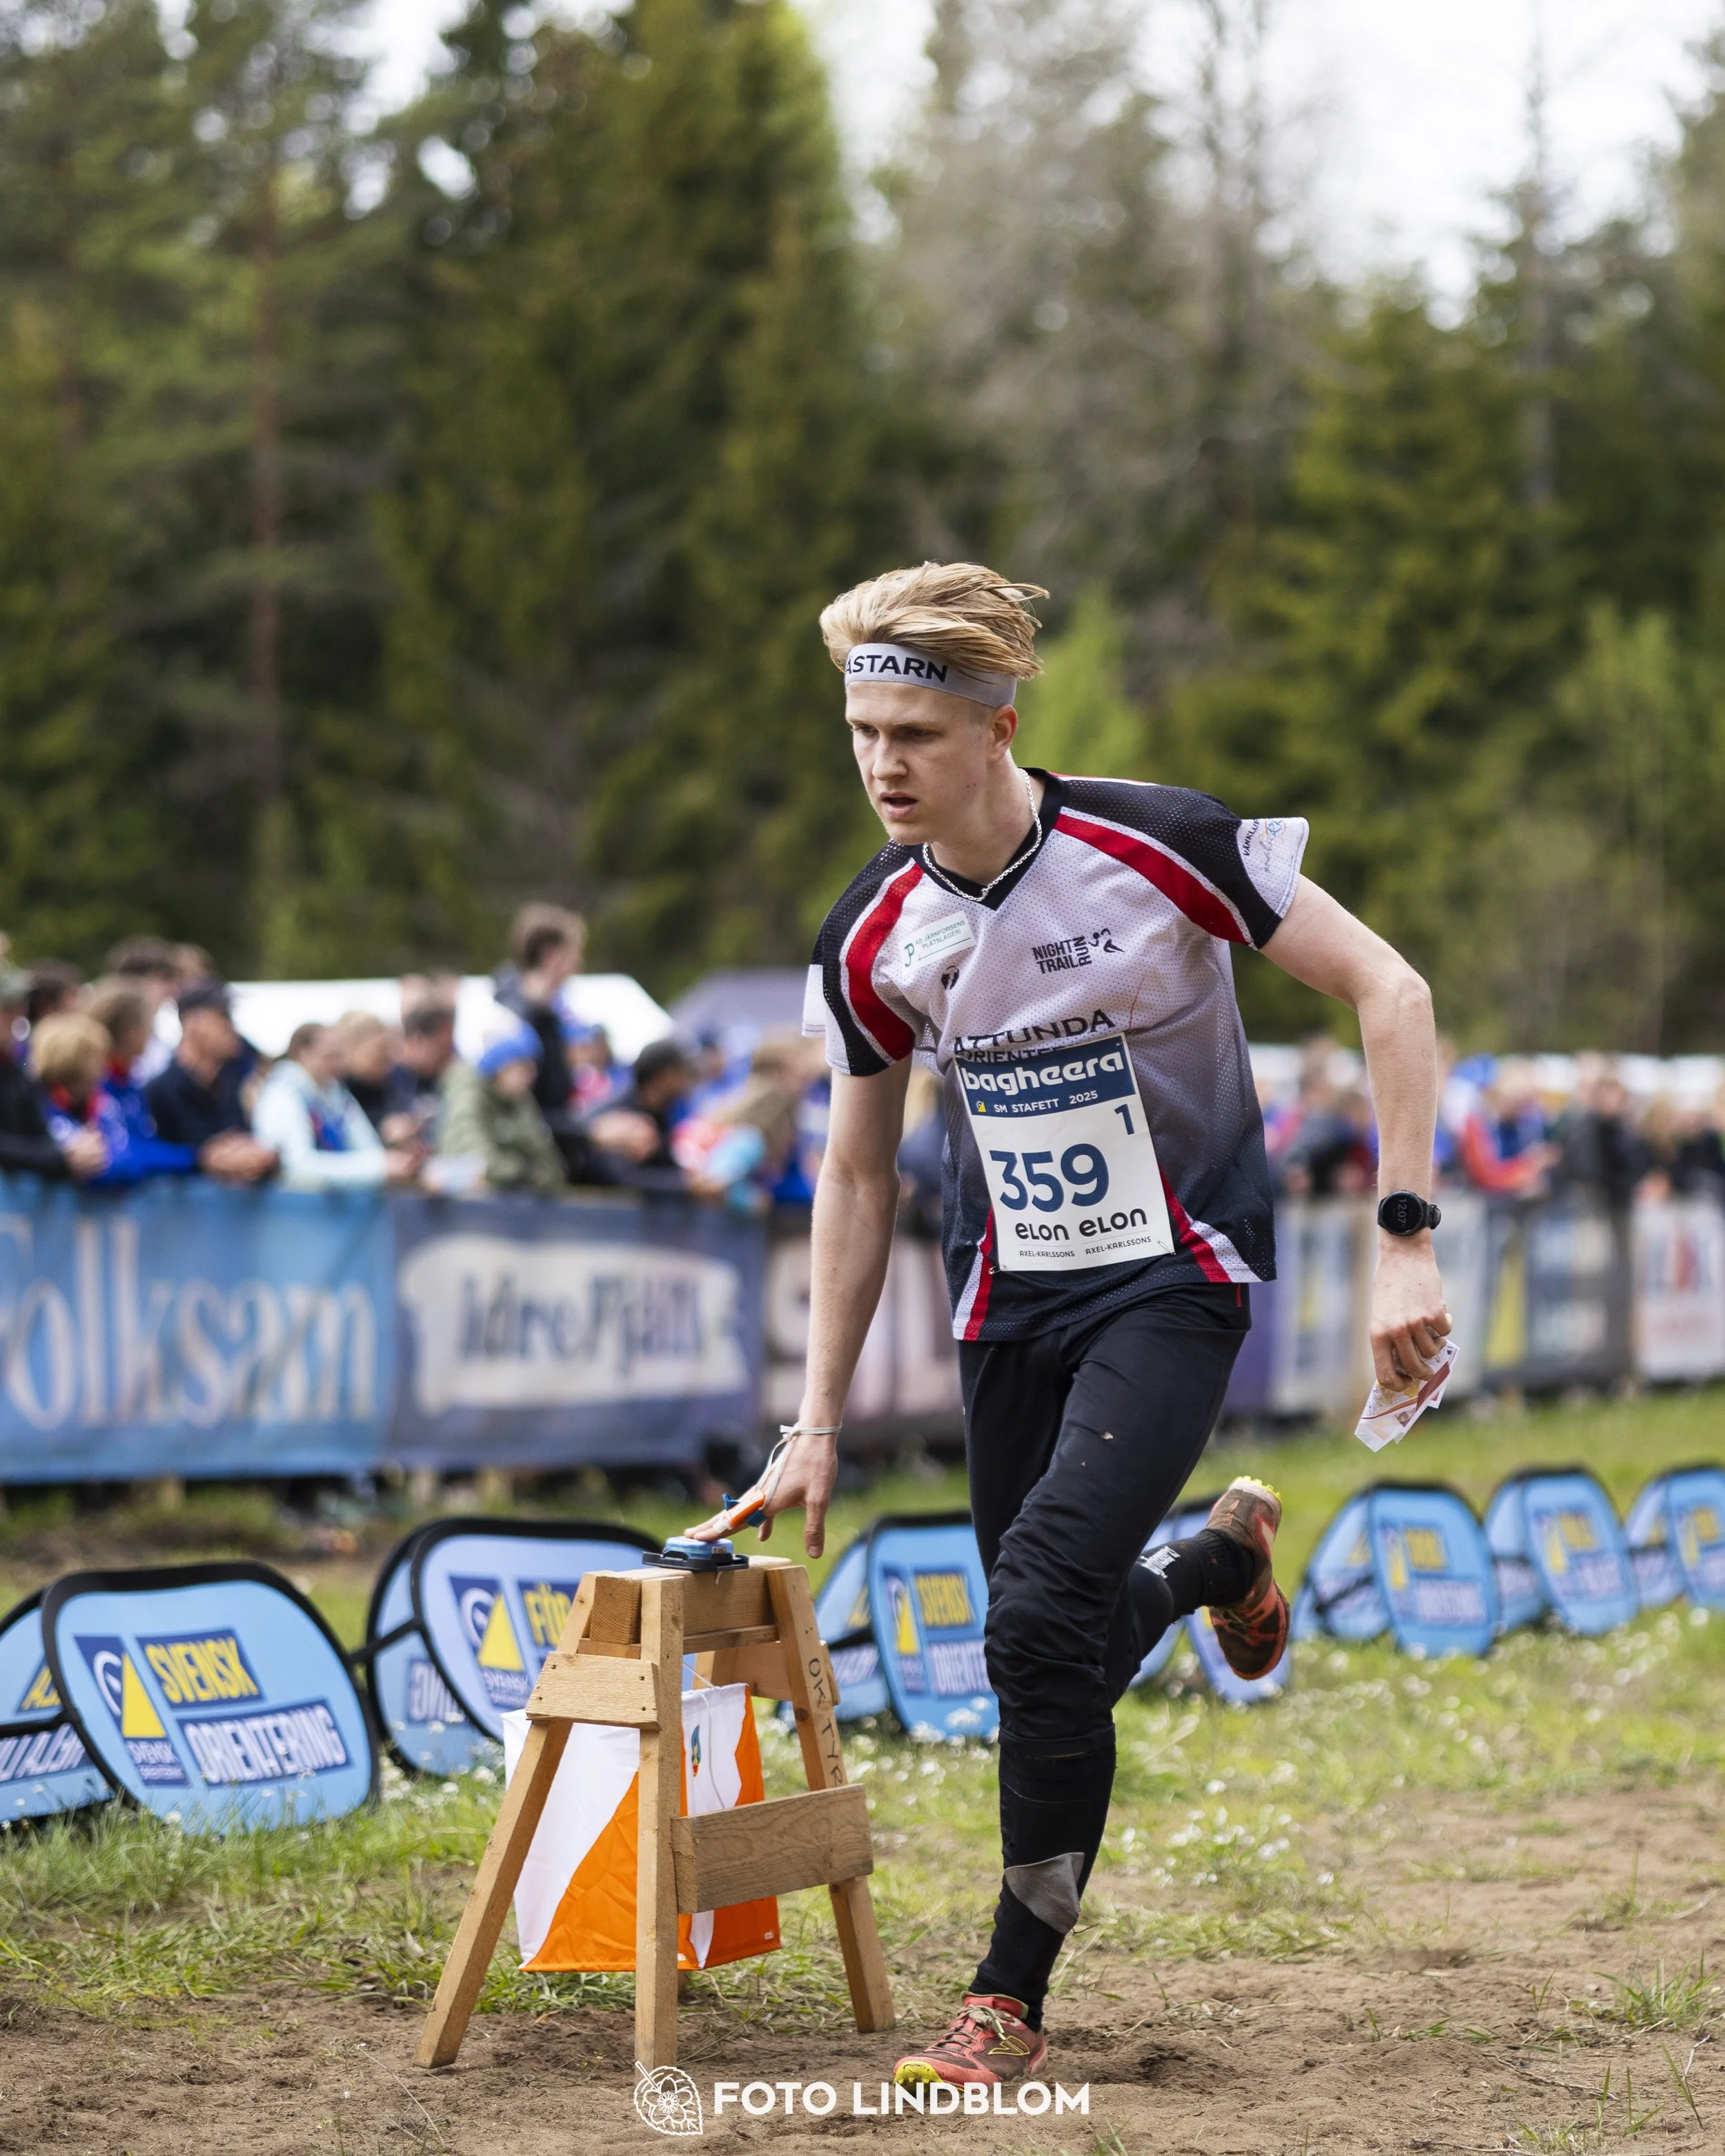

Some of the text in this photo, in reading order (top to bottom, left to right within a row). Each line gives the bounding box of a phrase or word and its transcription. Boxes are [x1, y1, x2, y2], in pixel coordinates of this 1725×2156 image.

[1032, 939, 1073, 960] NIGHT
[1036, 955, 1079, 974] TRAIL
[1072, 936, 1092, 967] RUN
[954, 1009, 1116, 1055] ATTUNDA
[961, 1052, 1125, 1096] bagheera
[994, 1090, 1098, 1113] SM STAFETT 2025
[1114, 1104, 1135, 1136] 1
[989, 1143, 1110, 1213] 359
[1085, 1236, 1152, 1255] AXEL-KARLSSONS
[144, 1636, 259, 1704] SVENSK
[184, 1703, 347, 1785] ORIENTERING
